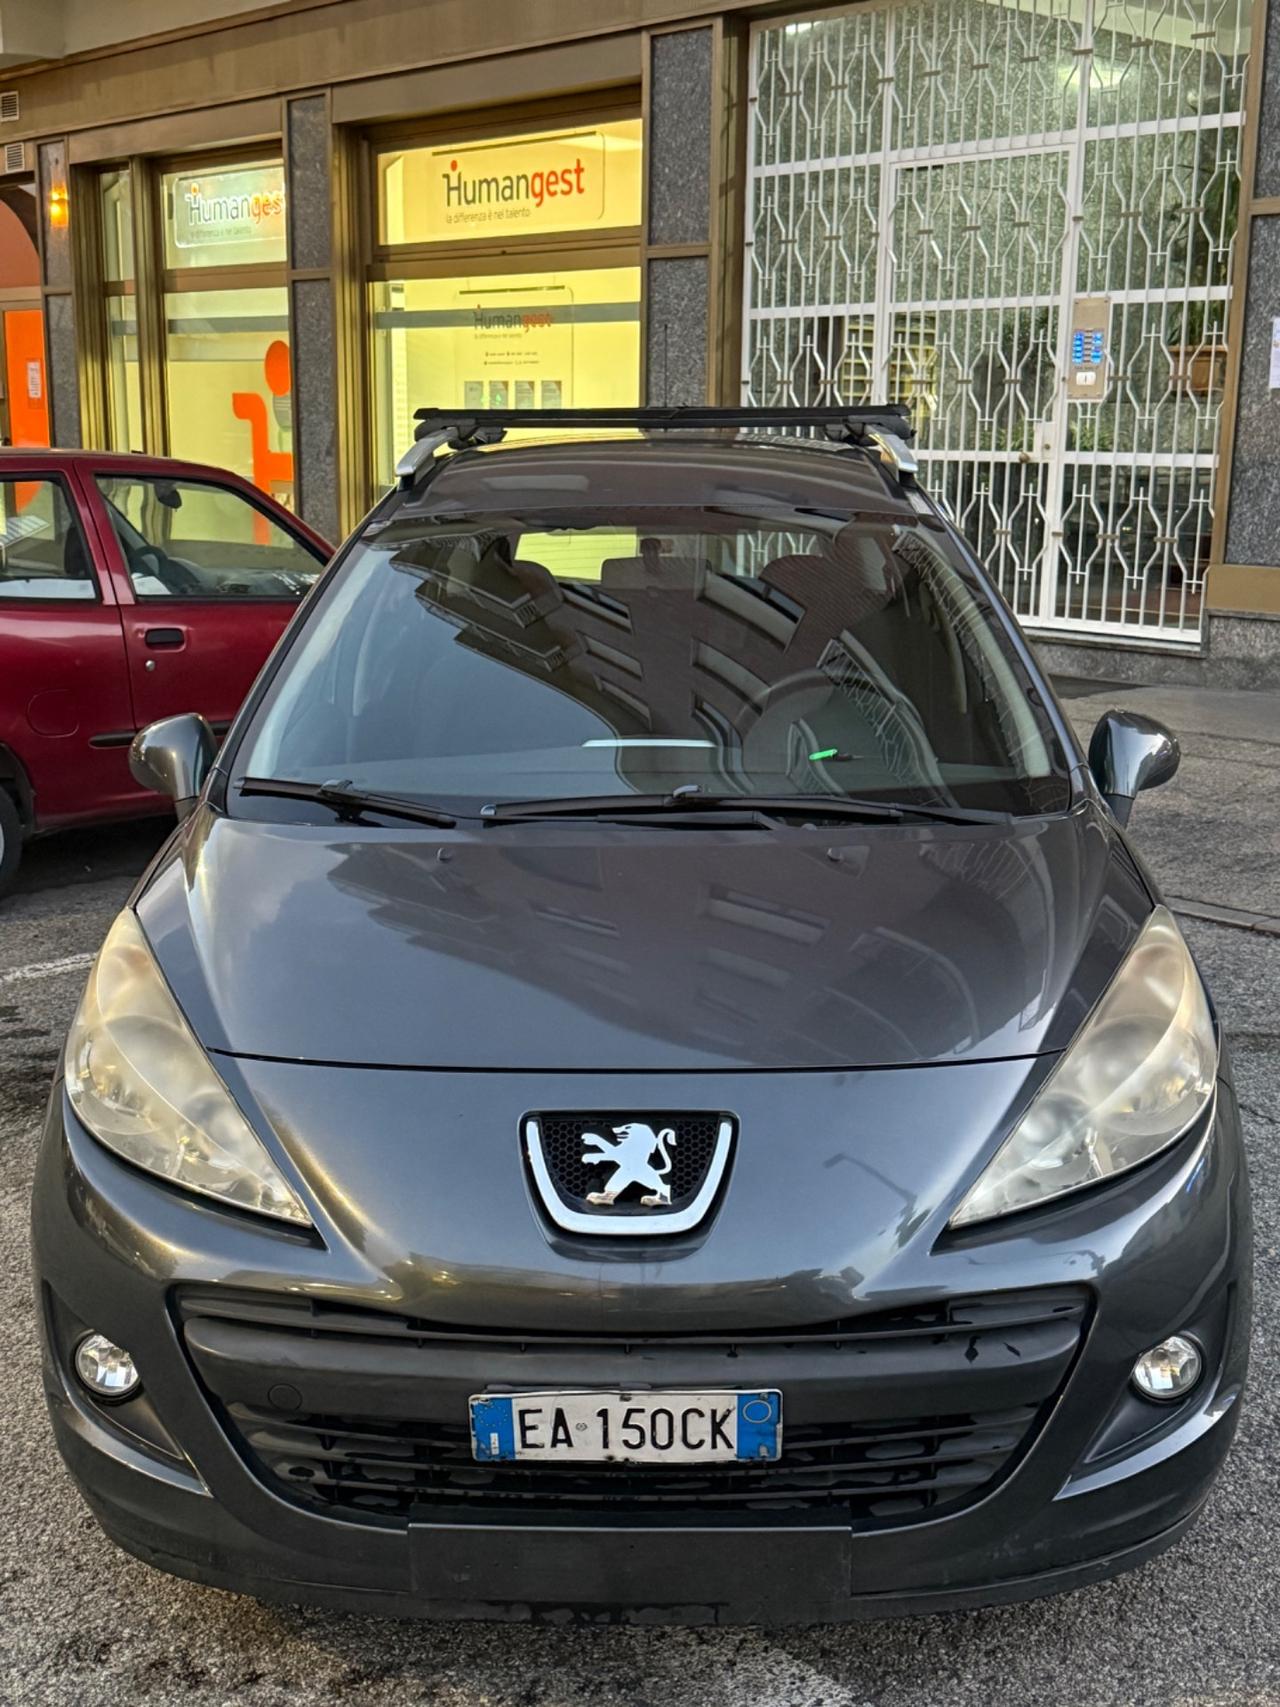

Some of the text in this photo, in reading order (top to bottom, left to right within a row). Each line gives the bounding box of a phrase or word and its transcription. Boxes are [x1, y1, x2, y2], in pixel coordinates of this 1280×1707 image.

[185, 183, 283, 225] Humanges
[442, 158, 585, 208] Humangest
[473, 304, 553, 333] Humangest
[518, 1408, 736, 1450] EA 150CK
